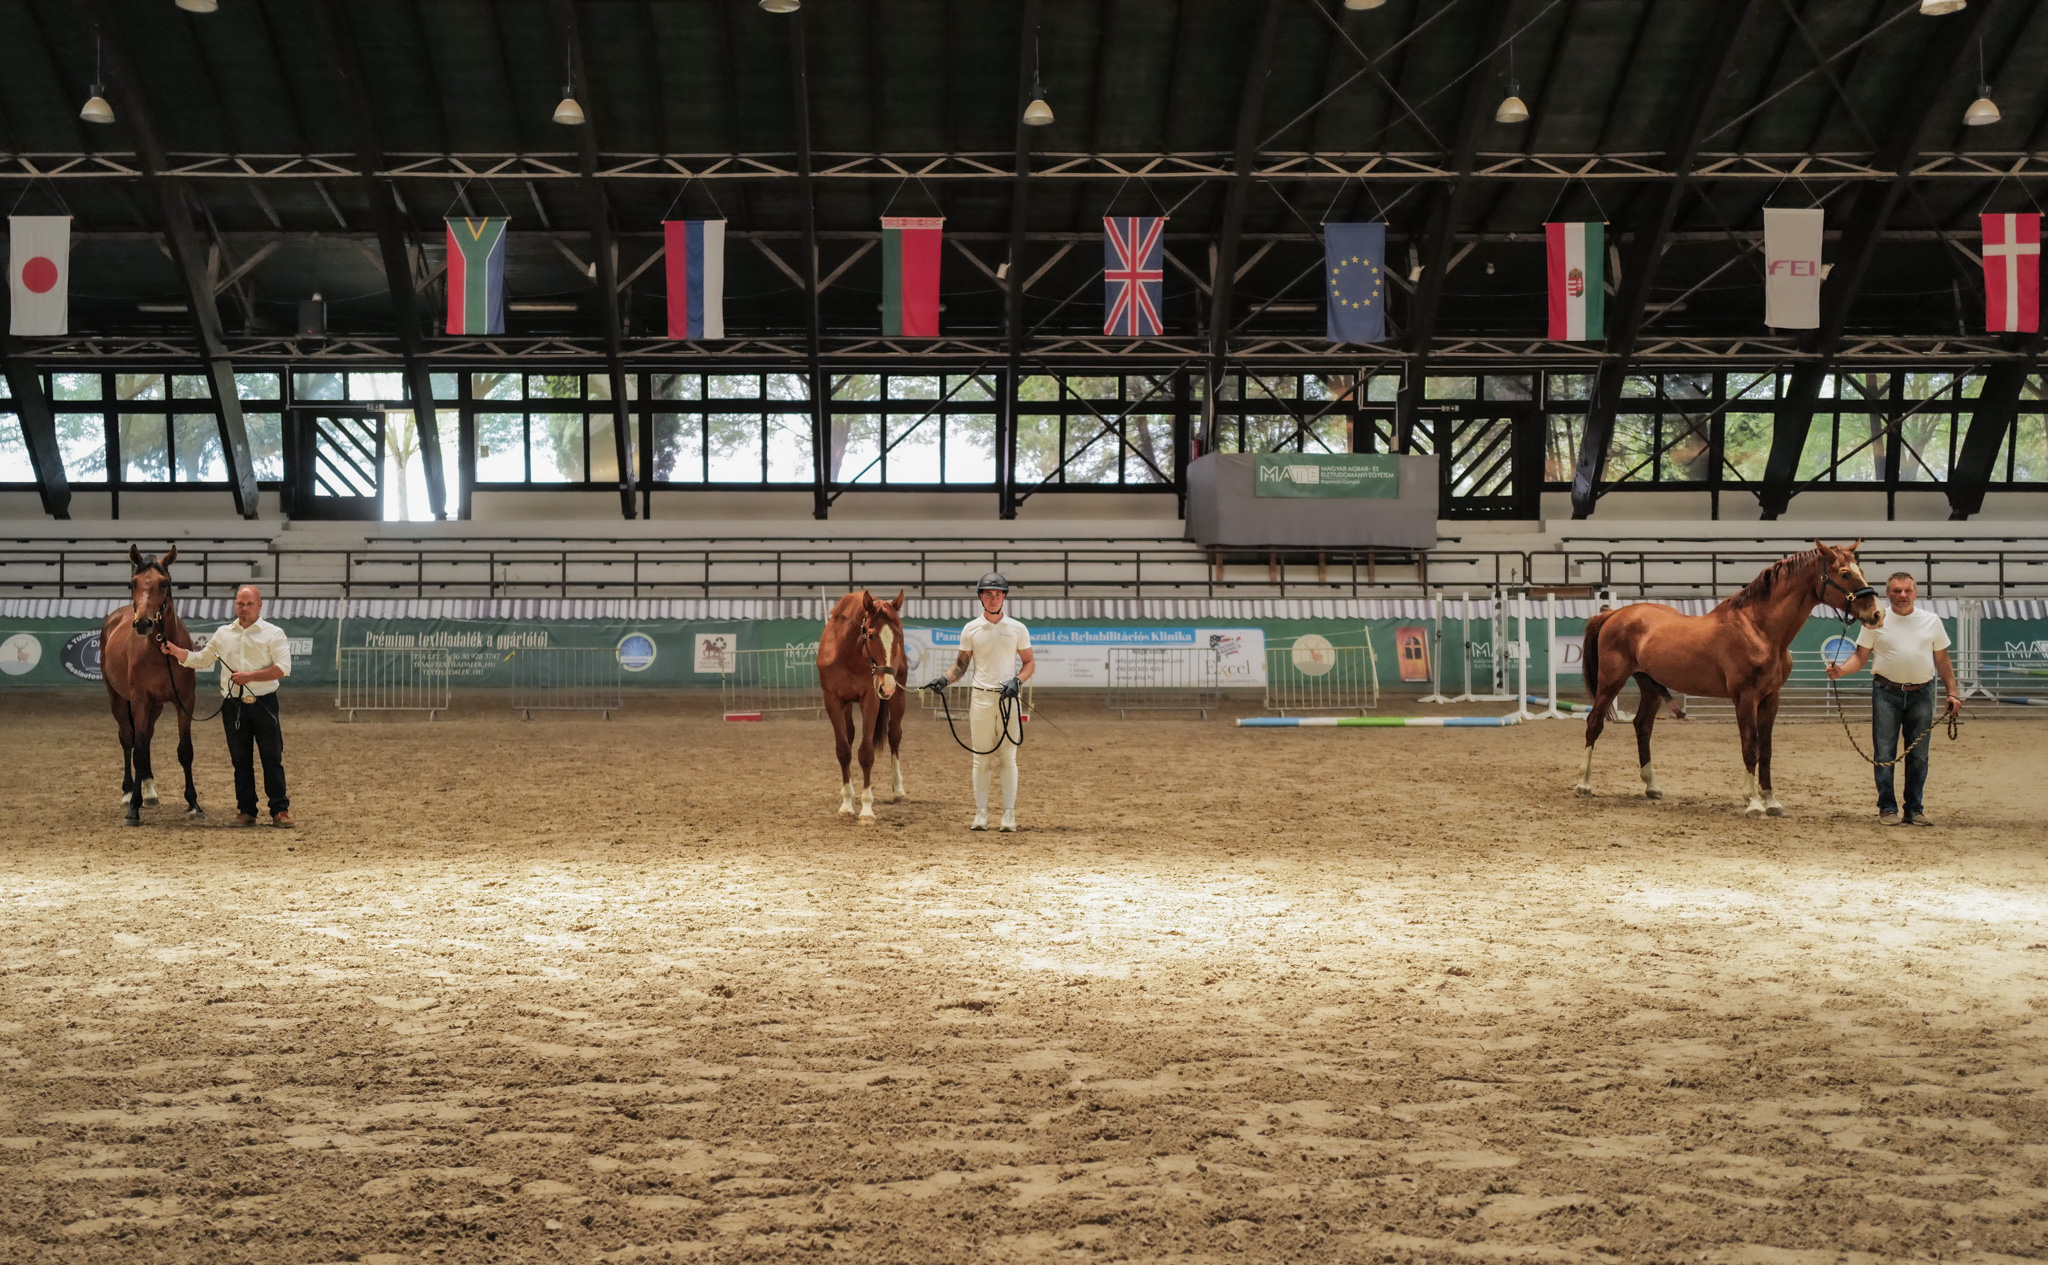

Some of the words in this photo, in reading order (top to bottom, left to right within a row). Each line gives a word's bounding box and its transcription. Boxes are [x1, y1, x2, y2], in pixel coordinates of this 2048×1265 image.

[1768, 260, 1815, 276] FEI
[1260, 465, 1319, 484] MATE
[365, 631, 414, 647] Prémium
[418, 631, 482, 647] textiladalék
[487, 636, 493, 647] a
[497, 631, 548, 650] gyártótól
[1057, 630, 1069, 641] és
[1071, 630, 1149, 641] Rehabilitációs
[1151, 631, 1192, 641] Klinika
[1205, 660, 1250, 676] Excel
